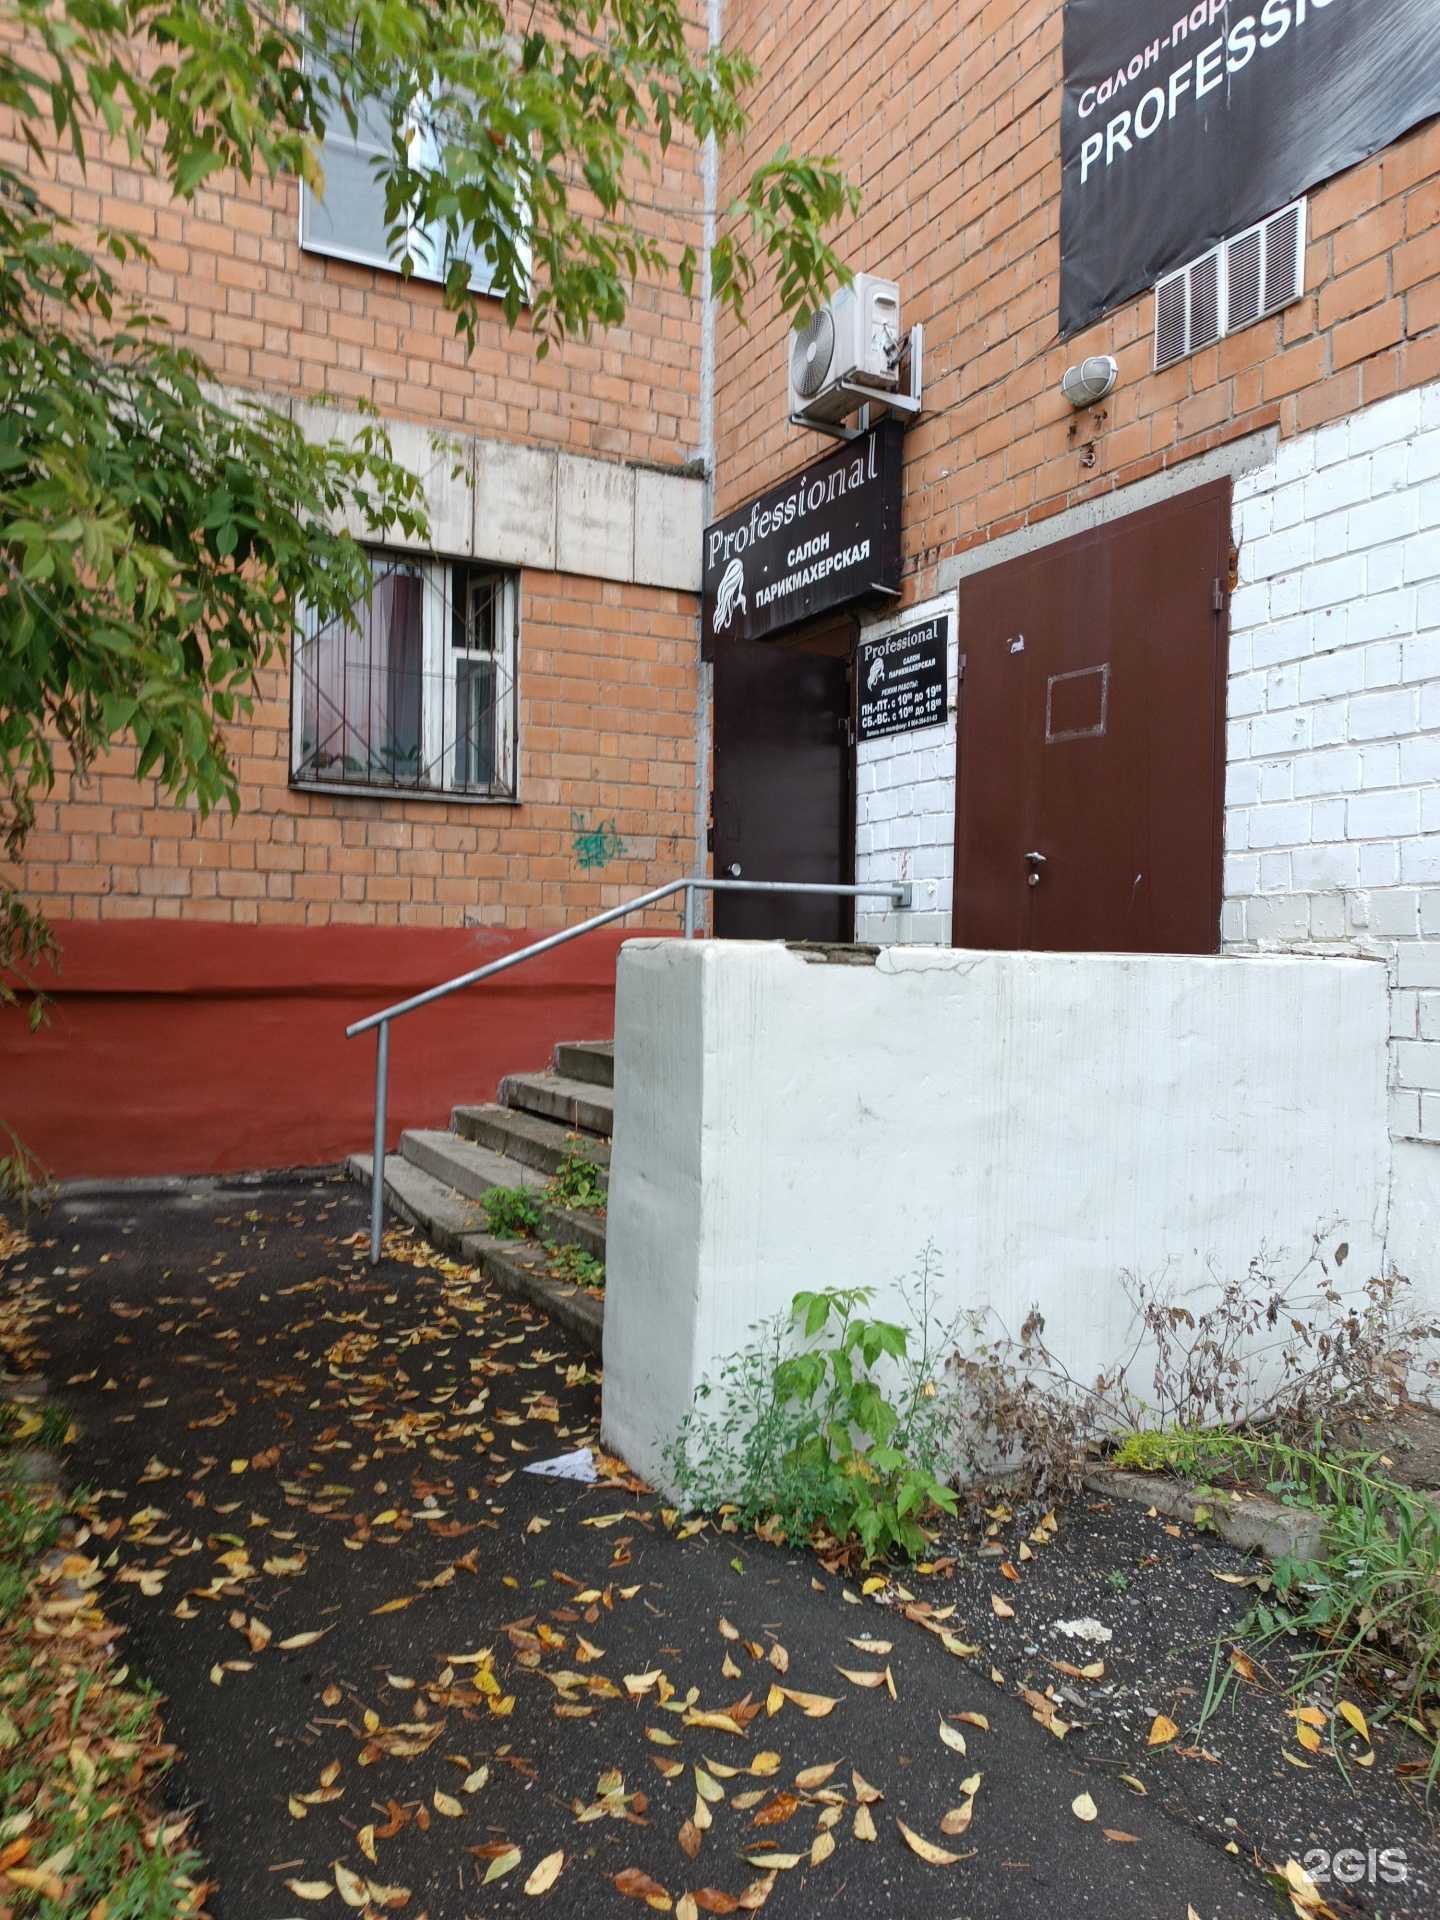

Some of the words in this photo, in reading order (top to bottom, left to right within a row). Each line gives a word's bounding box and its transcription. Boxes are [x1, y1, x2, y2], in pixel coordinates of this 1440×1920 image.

[1077, 0, 1232, 118] Салон-пар
[1080, 0, 1334, 184] PROFESSI
[707, 431, 878, 570] Professional
[755, 539, 871, 608] ПАРИКМАХЕРСКАЯ
[787, 532, 831, 567] САЛОН
[864, 620, 938, 662] Professional
[914, 692, 923, 703] до
[915, 705, 925, 716] до
